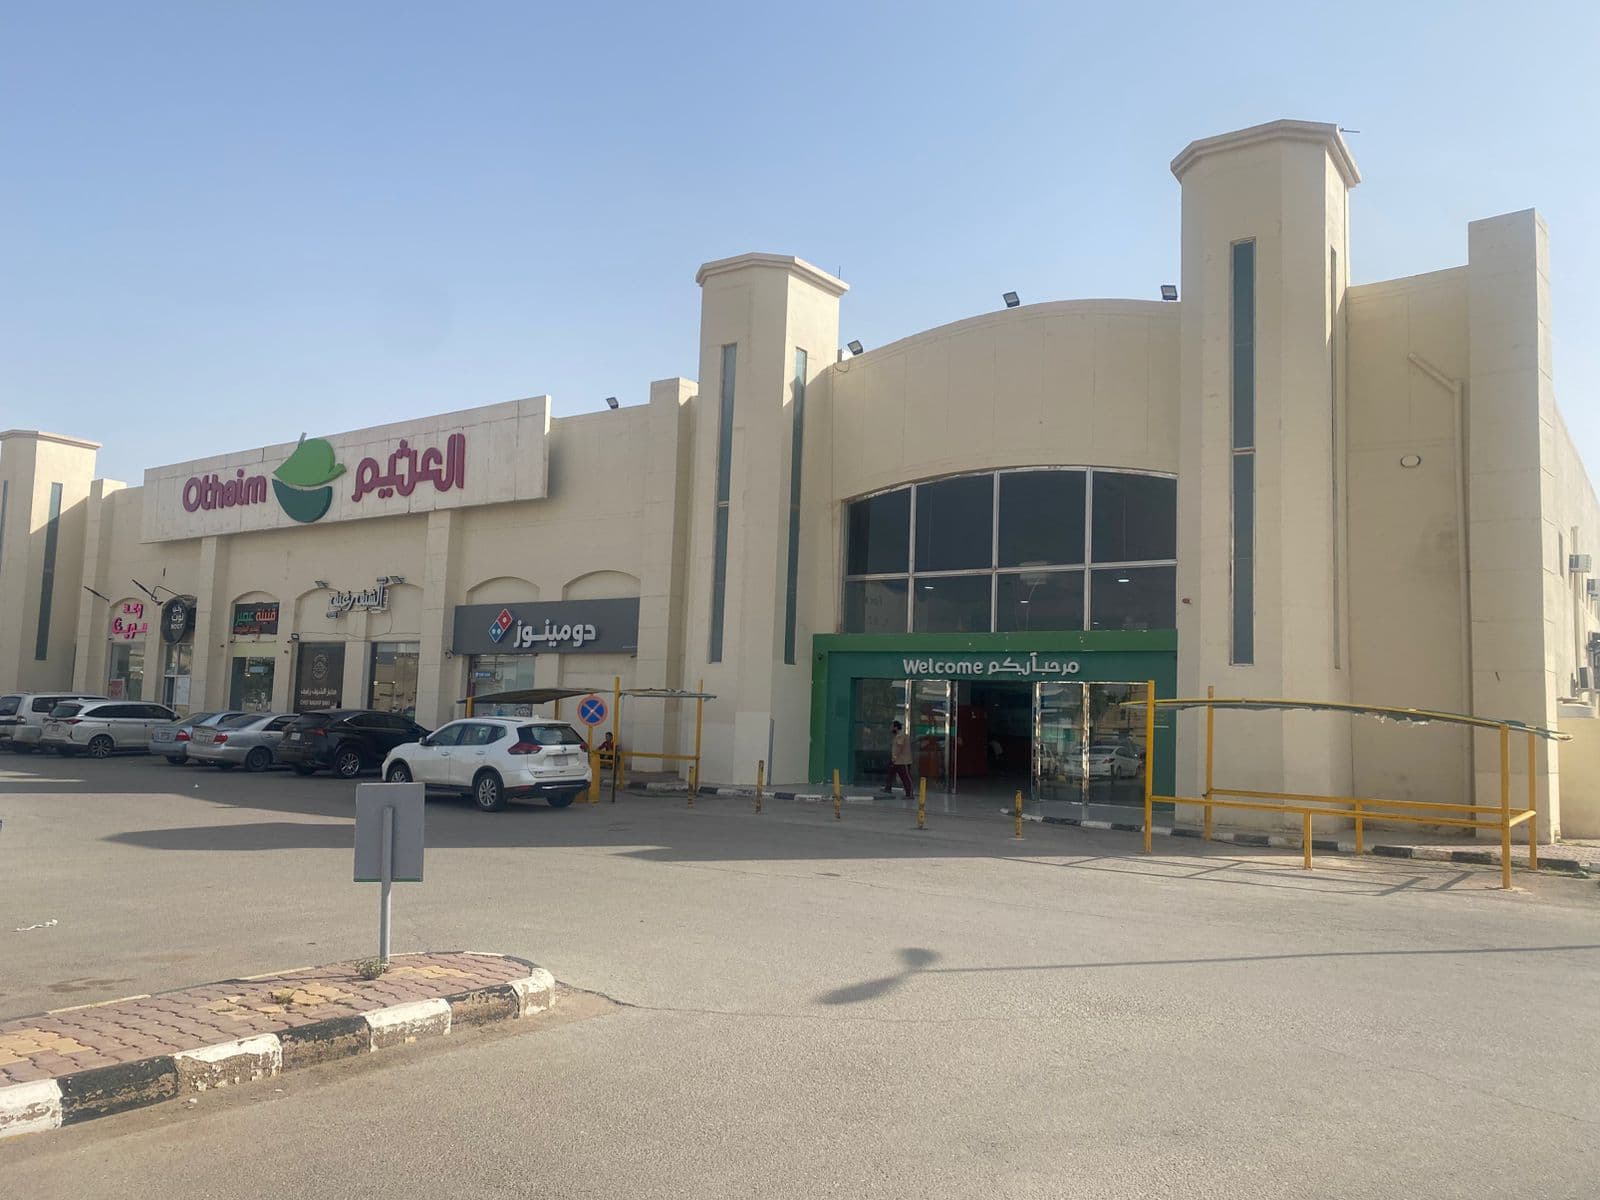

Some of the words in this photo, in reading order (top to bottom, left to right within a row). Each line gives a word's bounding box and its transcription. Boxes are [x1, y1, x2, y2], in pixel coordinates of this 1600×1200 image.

[351, 433, 466, 502] العثيم
[182, 468, 267, 512] Othaim
[513, 618, 597, 648] دومينوز
[902, 657, 984, 675] Welcome
